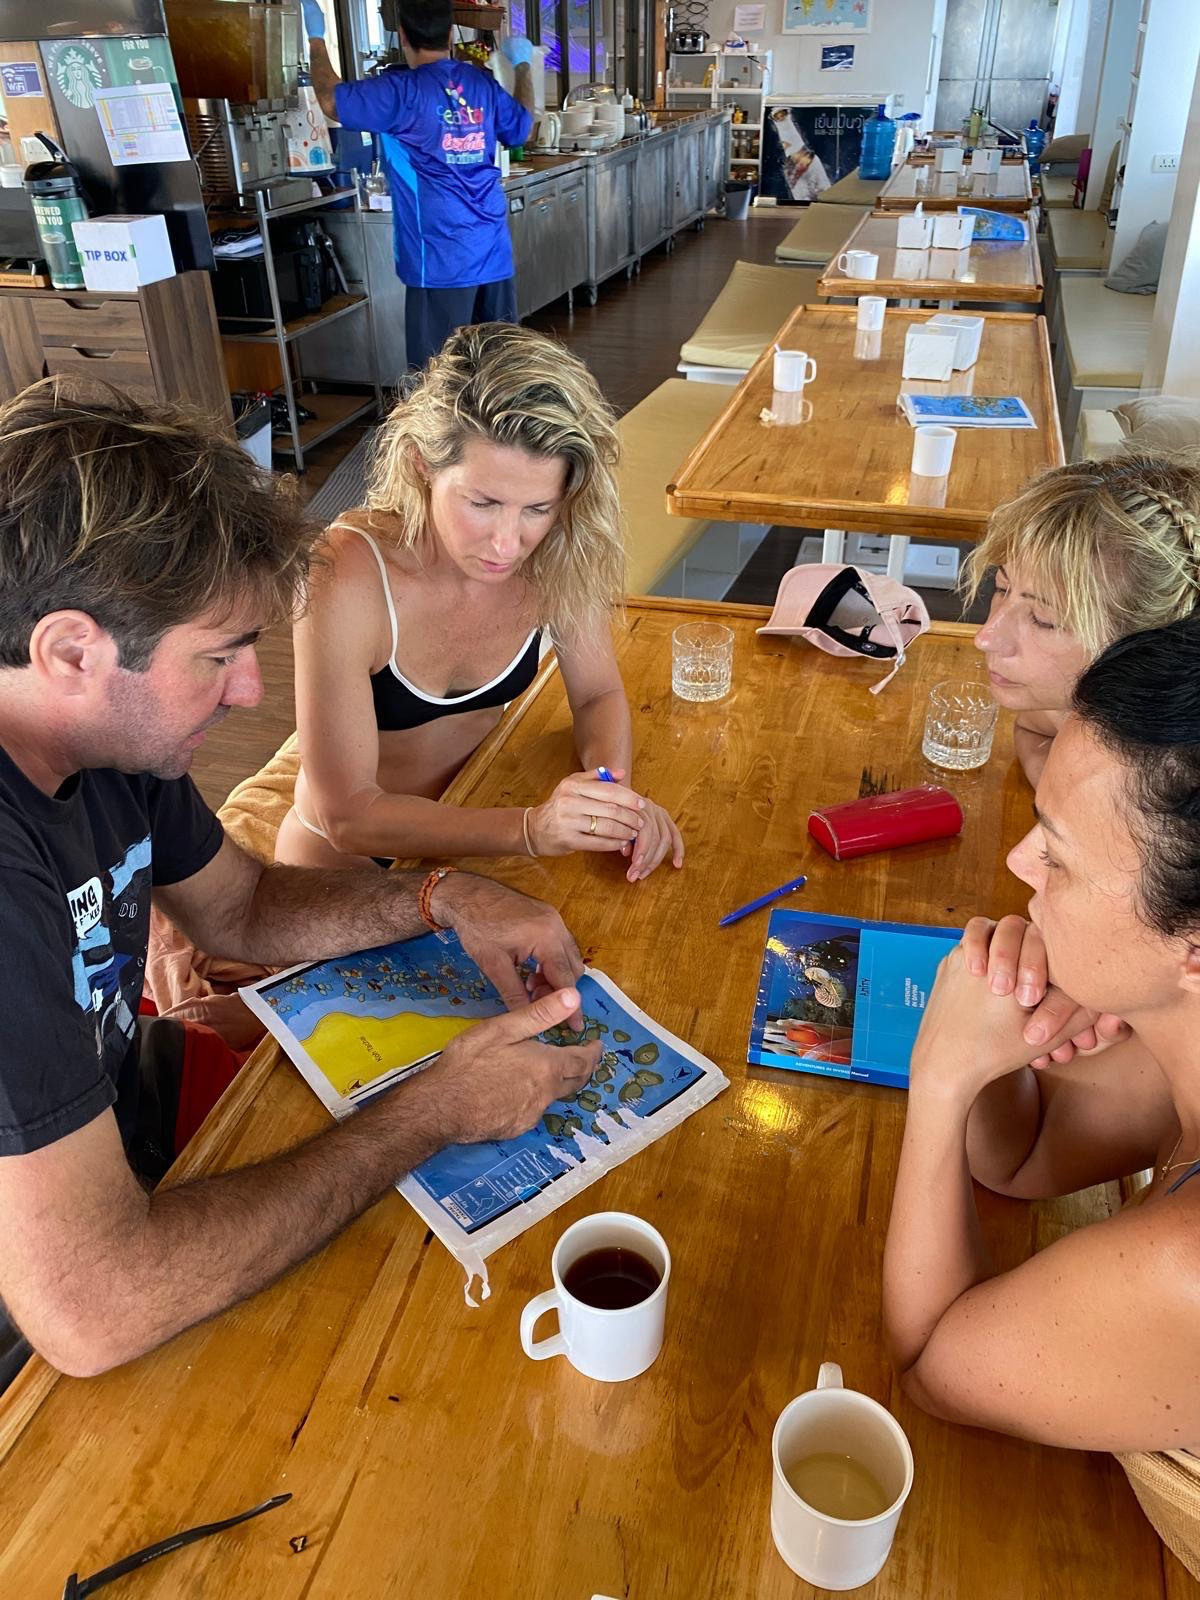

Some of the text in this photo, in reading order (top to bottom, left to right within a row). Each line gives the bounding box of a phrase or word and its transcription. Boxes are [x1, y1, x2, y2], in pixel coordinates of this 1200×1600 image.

[122, 40, 149, 50] FOR YOU
[47, 216, 63, 225] YOU
[85, 250, 127, 262] TIP BOX
